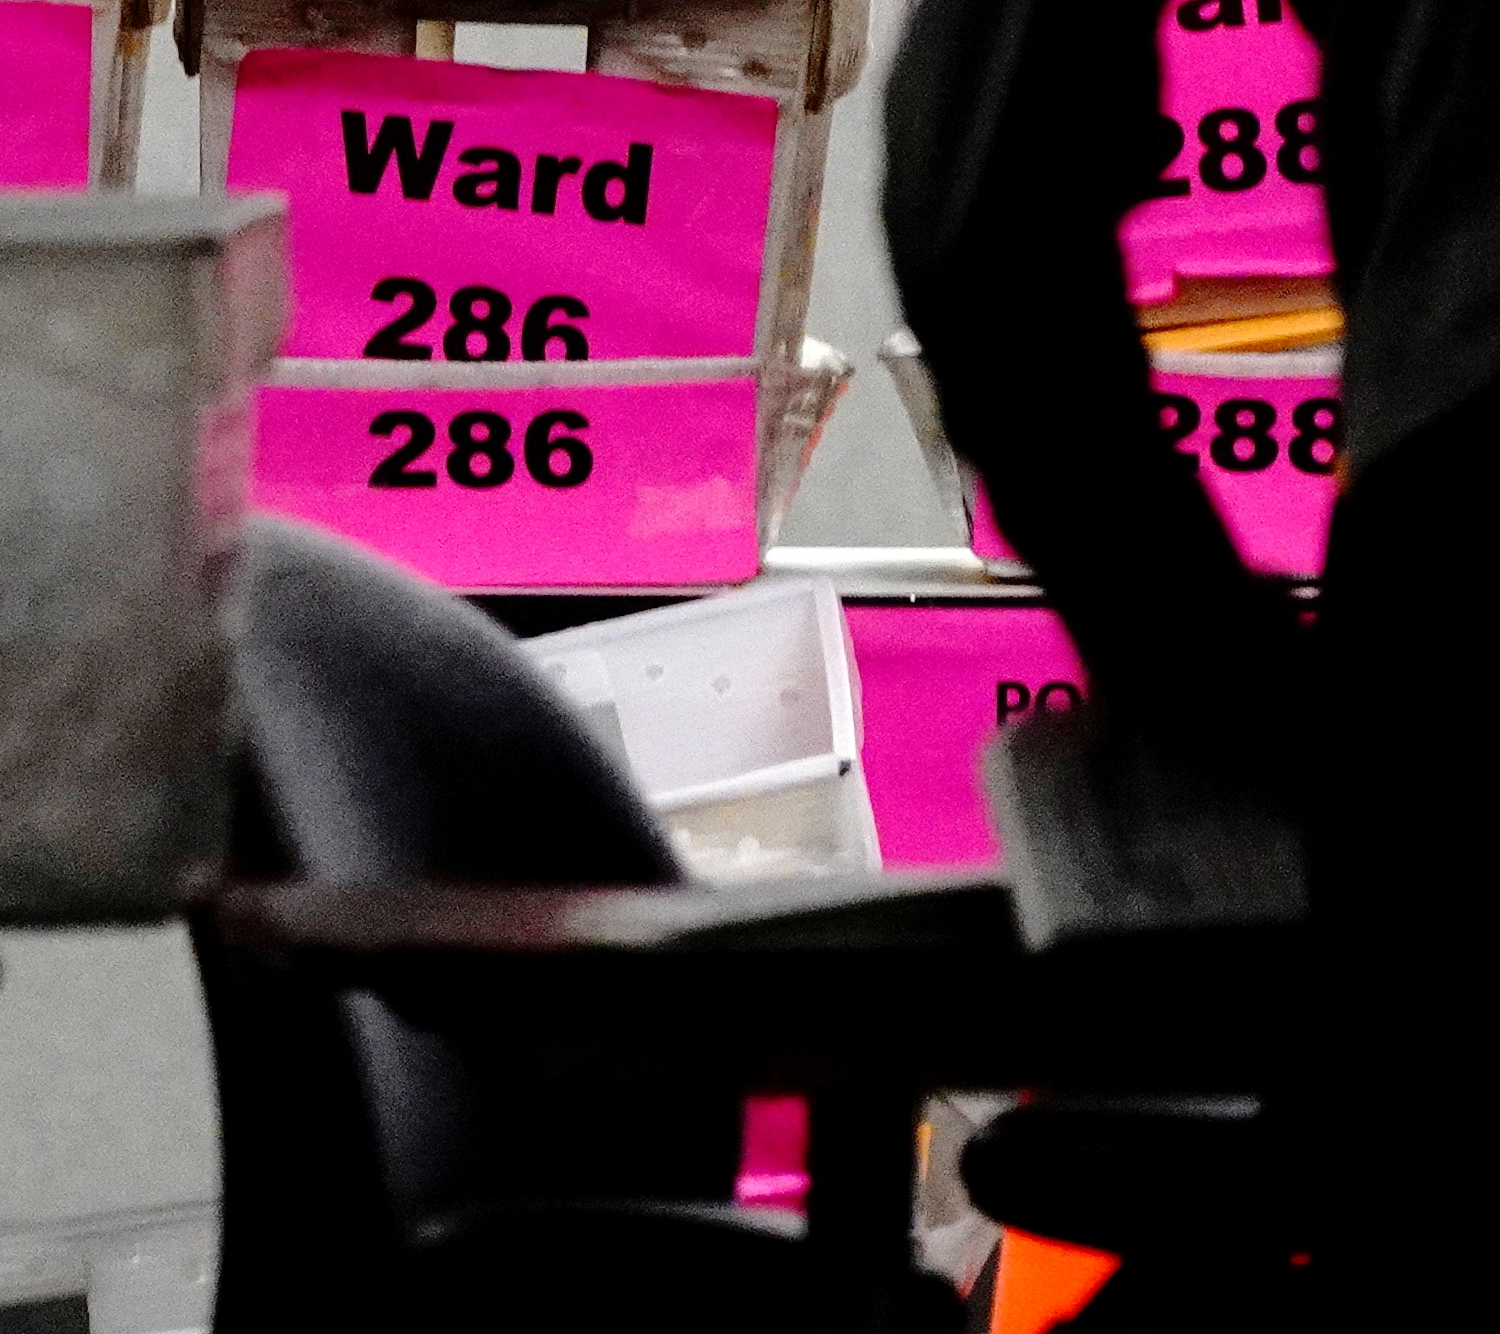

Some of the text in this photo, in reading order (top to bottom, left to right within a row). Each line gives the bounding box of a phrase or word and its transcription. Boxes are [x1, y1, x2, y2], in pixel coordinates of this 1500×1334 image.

[341, 110, 653, 225] Ward
[364, 277, 589, 359] 286
[369, 410, 593, 488] 286
